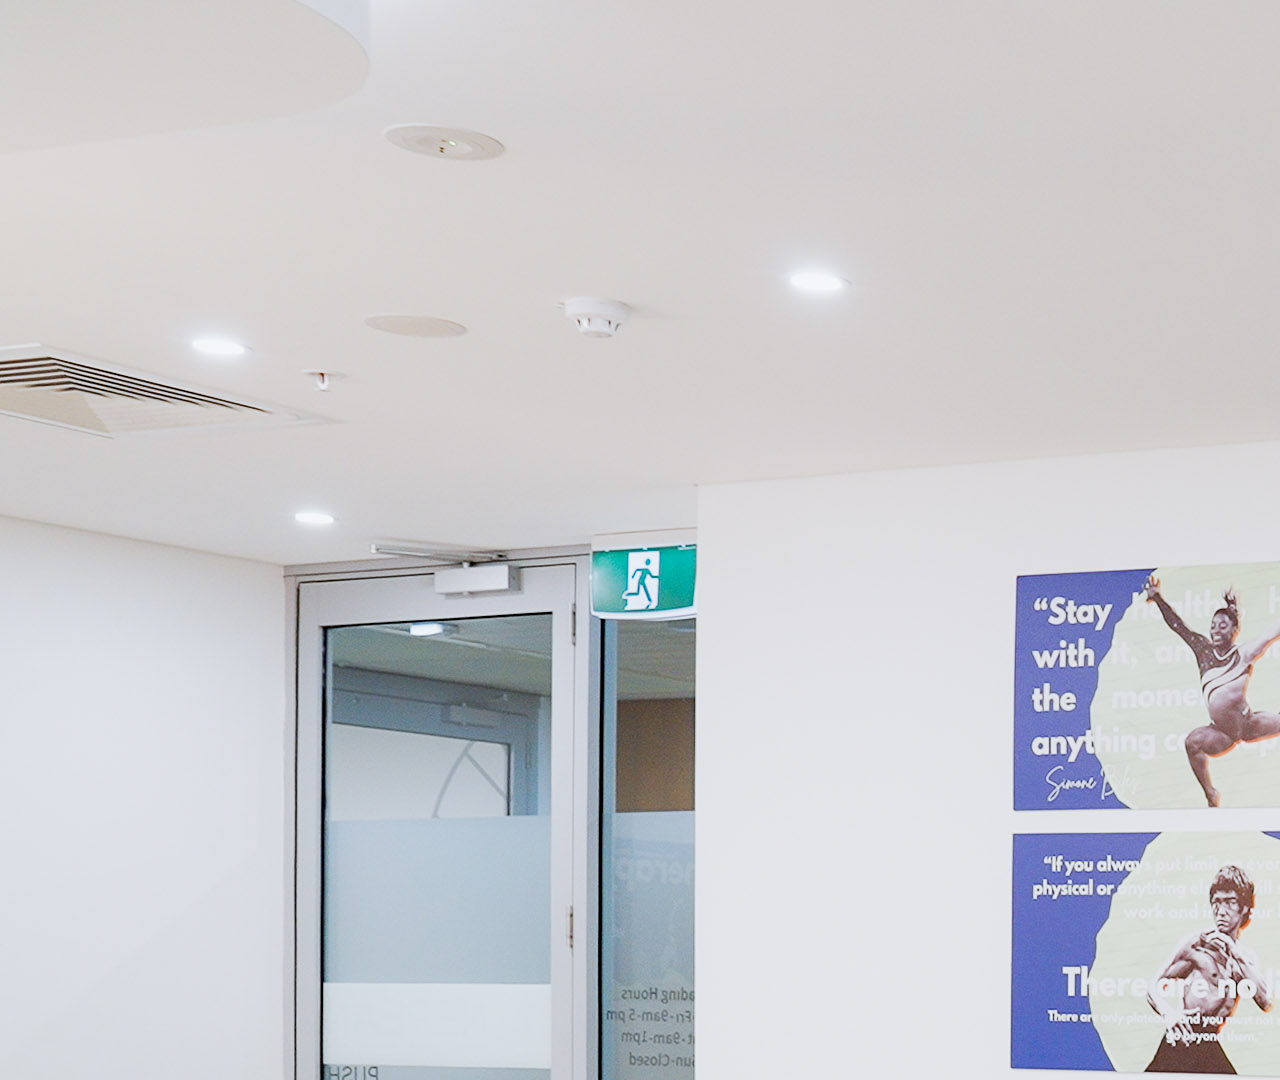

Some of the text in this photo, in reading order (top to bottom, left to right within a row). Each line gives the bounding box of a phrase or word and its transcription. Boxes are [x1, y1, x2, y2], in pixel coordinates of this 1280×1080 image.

[1034, 595, 1113, 631] “Stay
[1032, 638, 1095, 669] with
[1032, 684, 1076, 712] the
[1032, 729, 1155, 762] anything
[1046, 766, 1096, 801] Simone
[1044, 857, 1064, 872] “If
[1065, 859, 1094, 874] you
[1033, 880, 1093, 899] physical
[1096, 882, 1114, 895] or
[1062, 965, 1145, 998] There
[1157, 976, 1208, 997] are
[1219, 977, 1257, 1000] no
[1048, 1011, 1078, 1022] There
